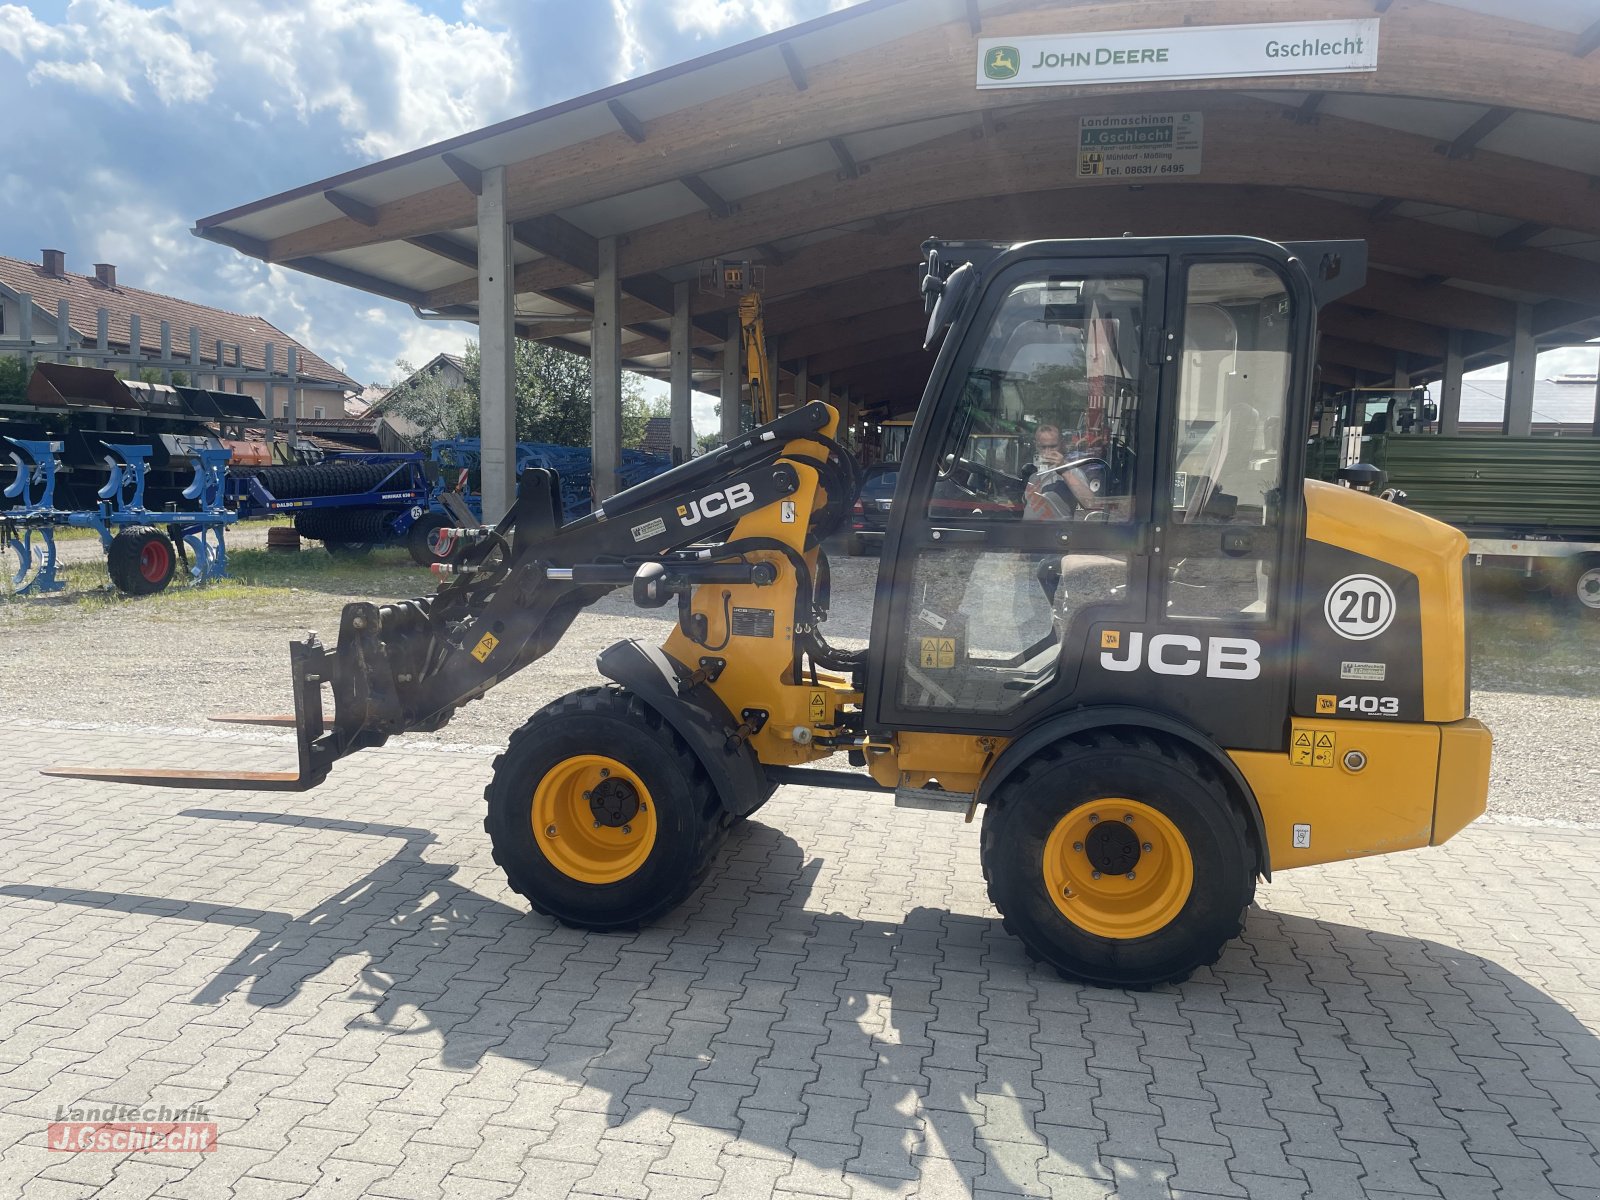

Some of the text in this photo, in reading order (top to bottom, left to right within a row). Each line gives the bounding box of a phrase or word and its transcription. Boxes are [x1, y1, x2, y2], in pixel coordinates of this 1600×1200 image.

[1265, 37, 1364, 58] Gschlecht
[1032, 48, 1169, 69] JOHN DEERE
[1081, 115, 1174, 127] Landmaschinen
[1084, 132, 1095, 144] J.
[1099, 128, 1170, 143] Gschlecht
[1106, 153, 1138, 161] Mühldorf
[1105, 166, 1122, 175] Tel.
[1124, 165, 1152, 175] 08631
[1161, 164, 1185, 173] 6495
[680, 482, 755, 527] JCB
[1338, 590, 1382, 624] 20
[1100, 631, 1261, 681] JCB
[1338, 695, 1399, 713] 403
